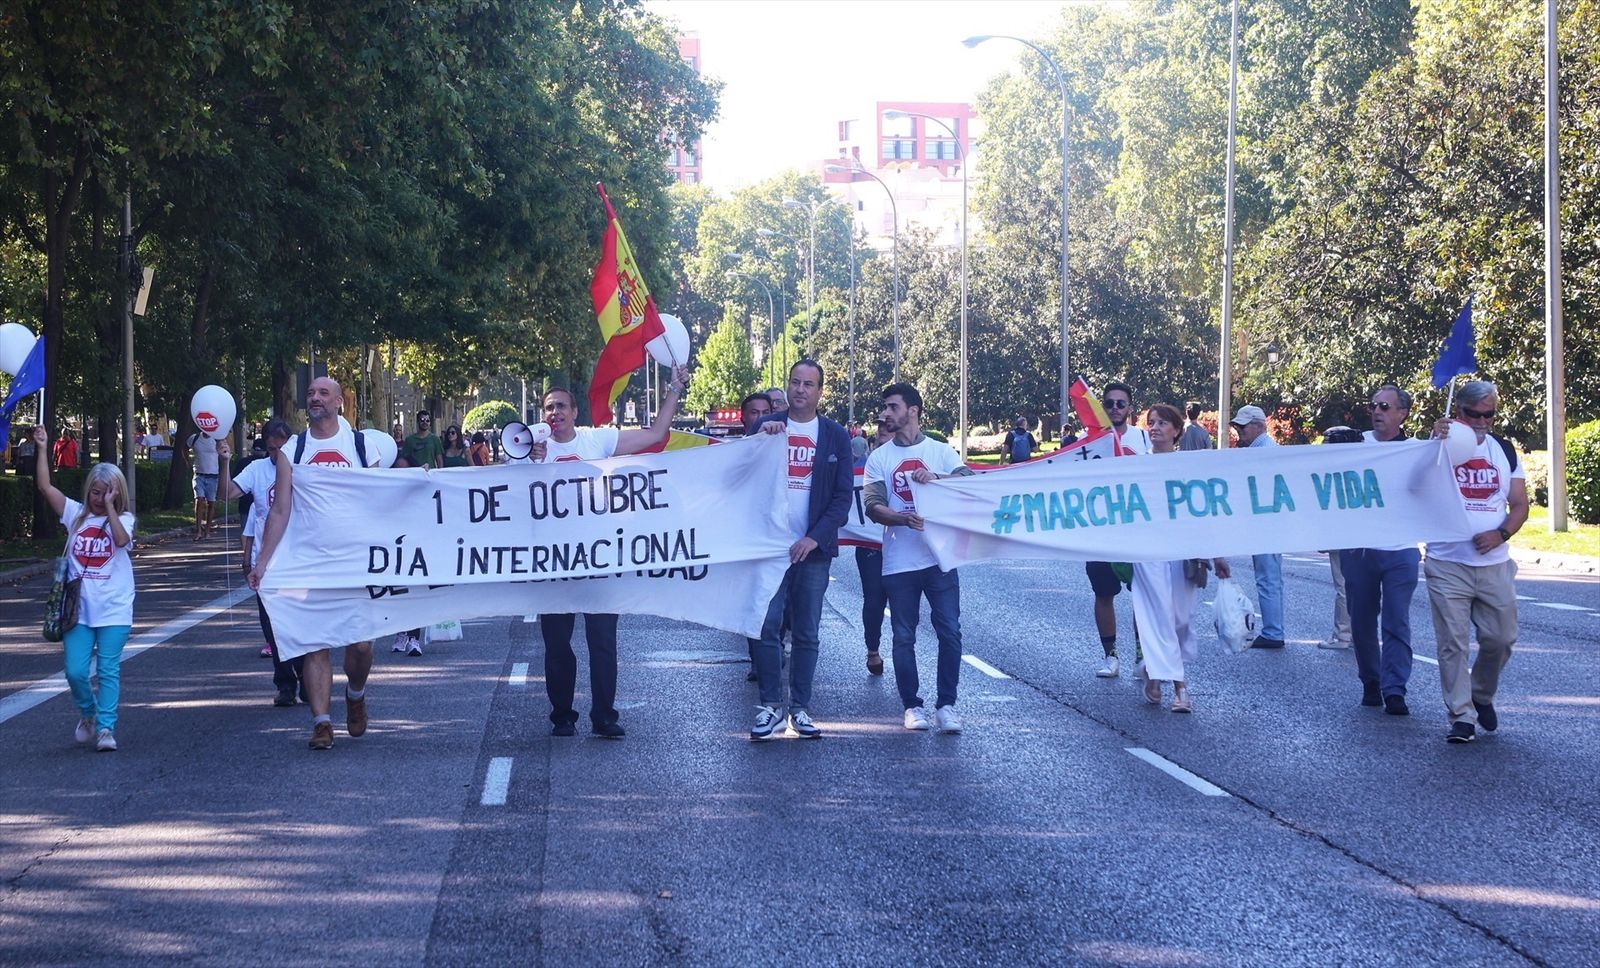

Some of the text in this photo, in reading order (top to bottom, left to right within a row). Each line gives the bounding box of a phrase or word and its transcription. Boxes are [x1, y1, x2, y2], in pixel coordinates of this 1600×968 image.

[789, 446, 816, 462] TOP
[1457, 466, 1498, 484] STOP
[432, 468, 669, 524] 1 DE OCTUBRE
[991, 468, 1385, 534] #MARCHA POR LA VIDA
[75, 535, 111, 552] STOP
[367, 534, 429, 577] DÍA
